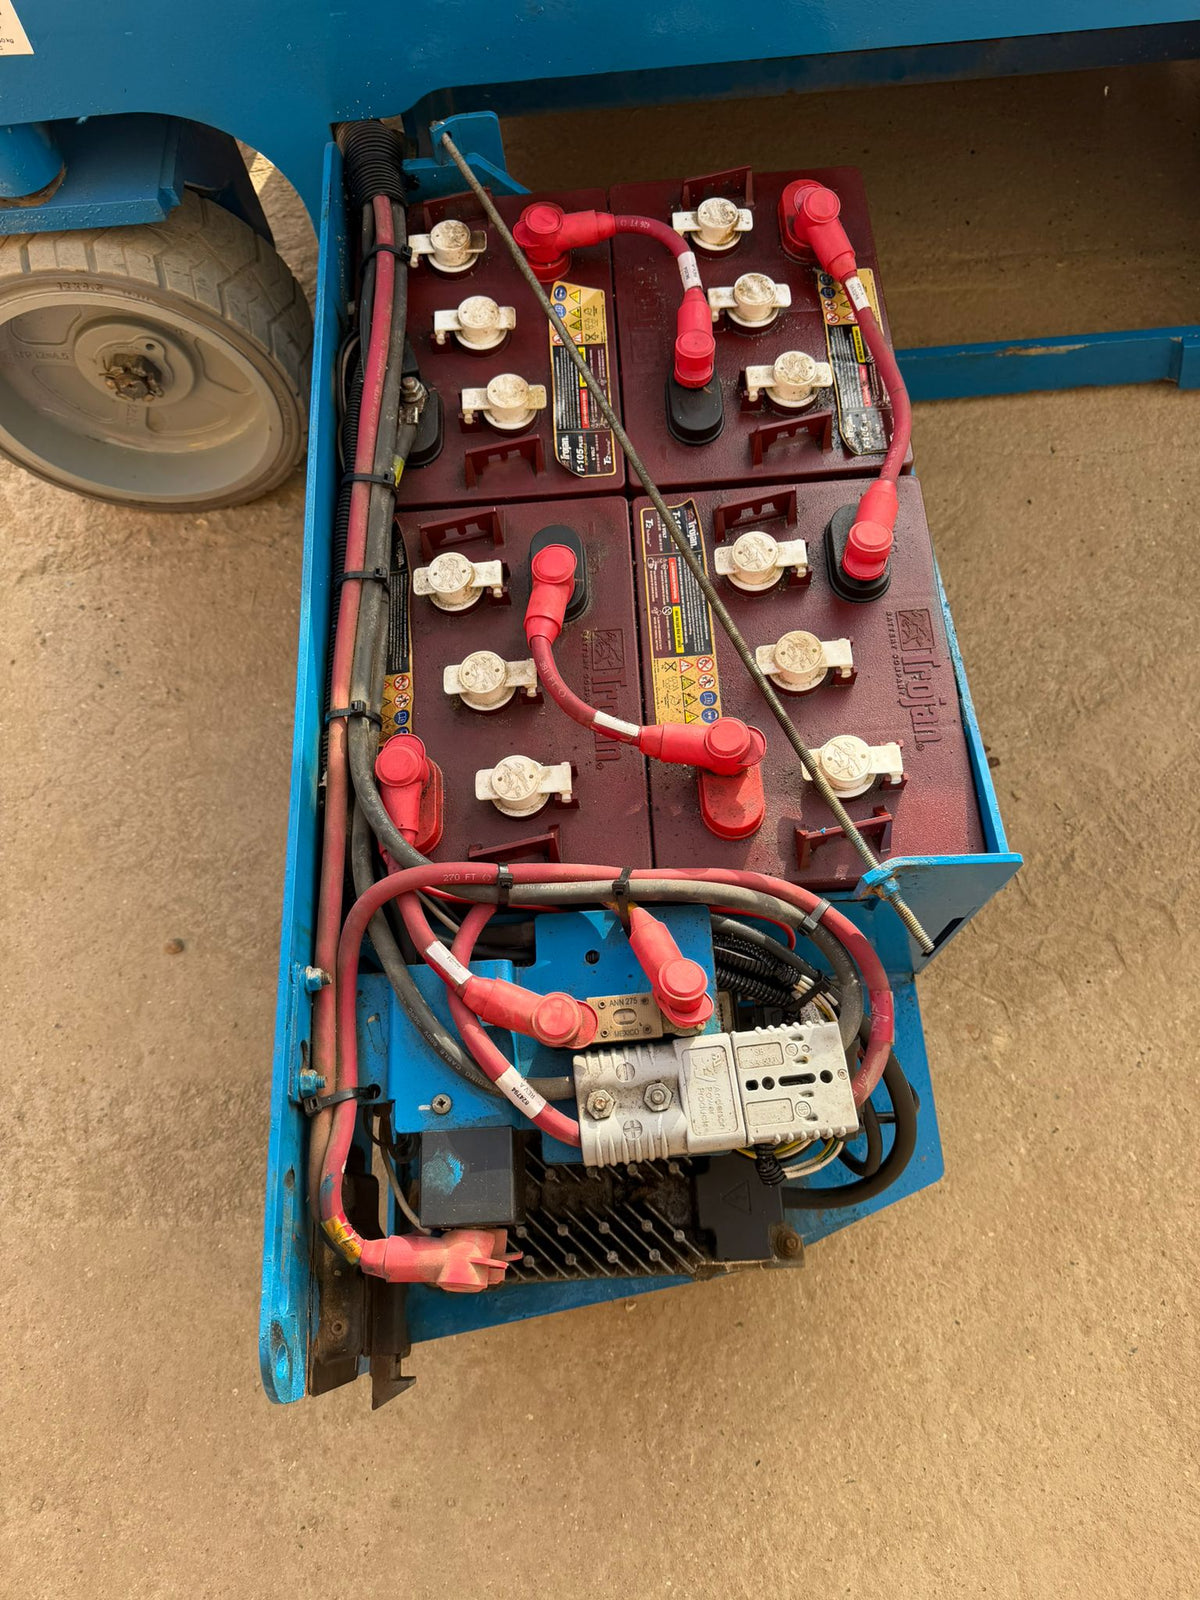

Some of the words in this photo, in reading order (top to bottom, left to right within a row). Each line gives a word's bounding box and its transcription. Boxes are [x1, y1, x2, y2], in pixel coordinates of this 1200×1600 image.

[560, 435, 571, 460] Trojan
[687, 519, 698, 548] Trojan
[442, 873, 460, 882] 270
[464, 873, 476, 881] FT
[610, 999, 625, 1007] ANN
[625, 997, 638, 1006] 275
[614, 1029, 639, 1037] MEXICO
